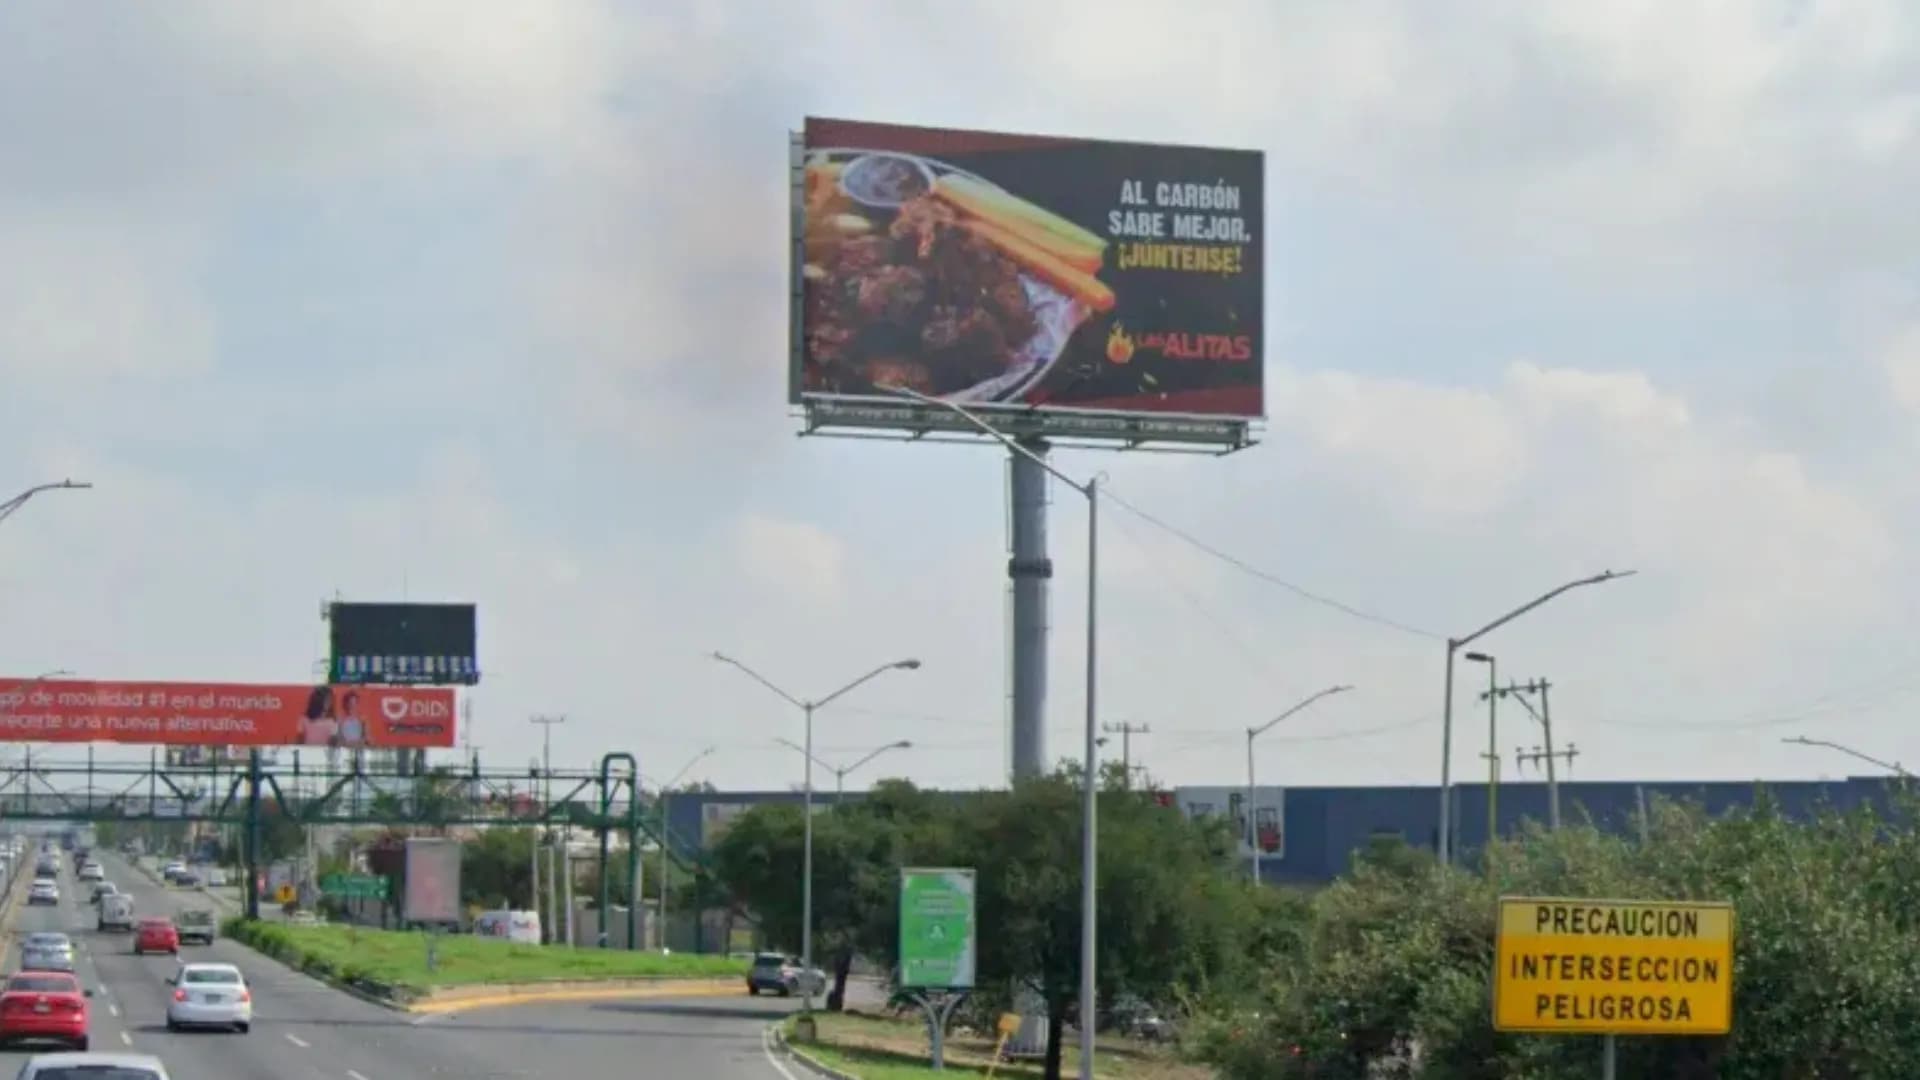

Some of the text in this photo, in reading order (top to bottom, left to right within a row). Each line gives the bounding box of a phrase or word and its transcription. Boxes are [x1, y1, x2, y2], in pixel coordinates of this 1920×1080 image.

[1120, 177, 1240, 210] AL CARBÓN
[1108, 210, 1251, 242] SABE MEJOR.
[1162, 332, 1250, 360] ALITAS
[29, 689, 54, 706] de
[58, 690, 143, 707] movilidad
[170, 695, 194, 709] en
[219, 693, 282, 710] mundo
[1536, 906, 1698, 937] PRECAUCION
[1510, 954, 1718, 982] INTERSECCION
[1536, 994, 1691, 1020] PELIGROSA
